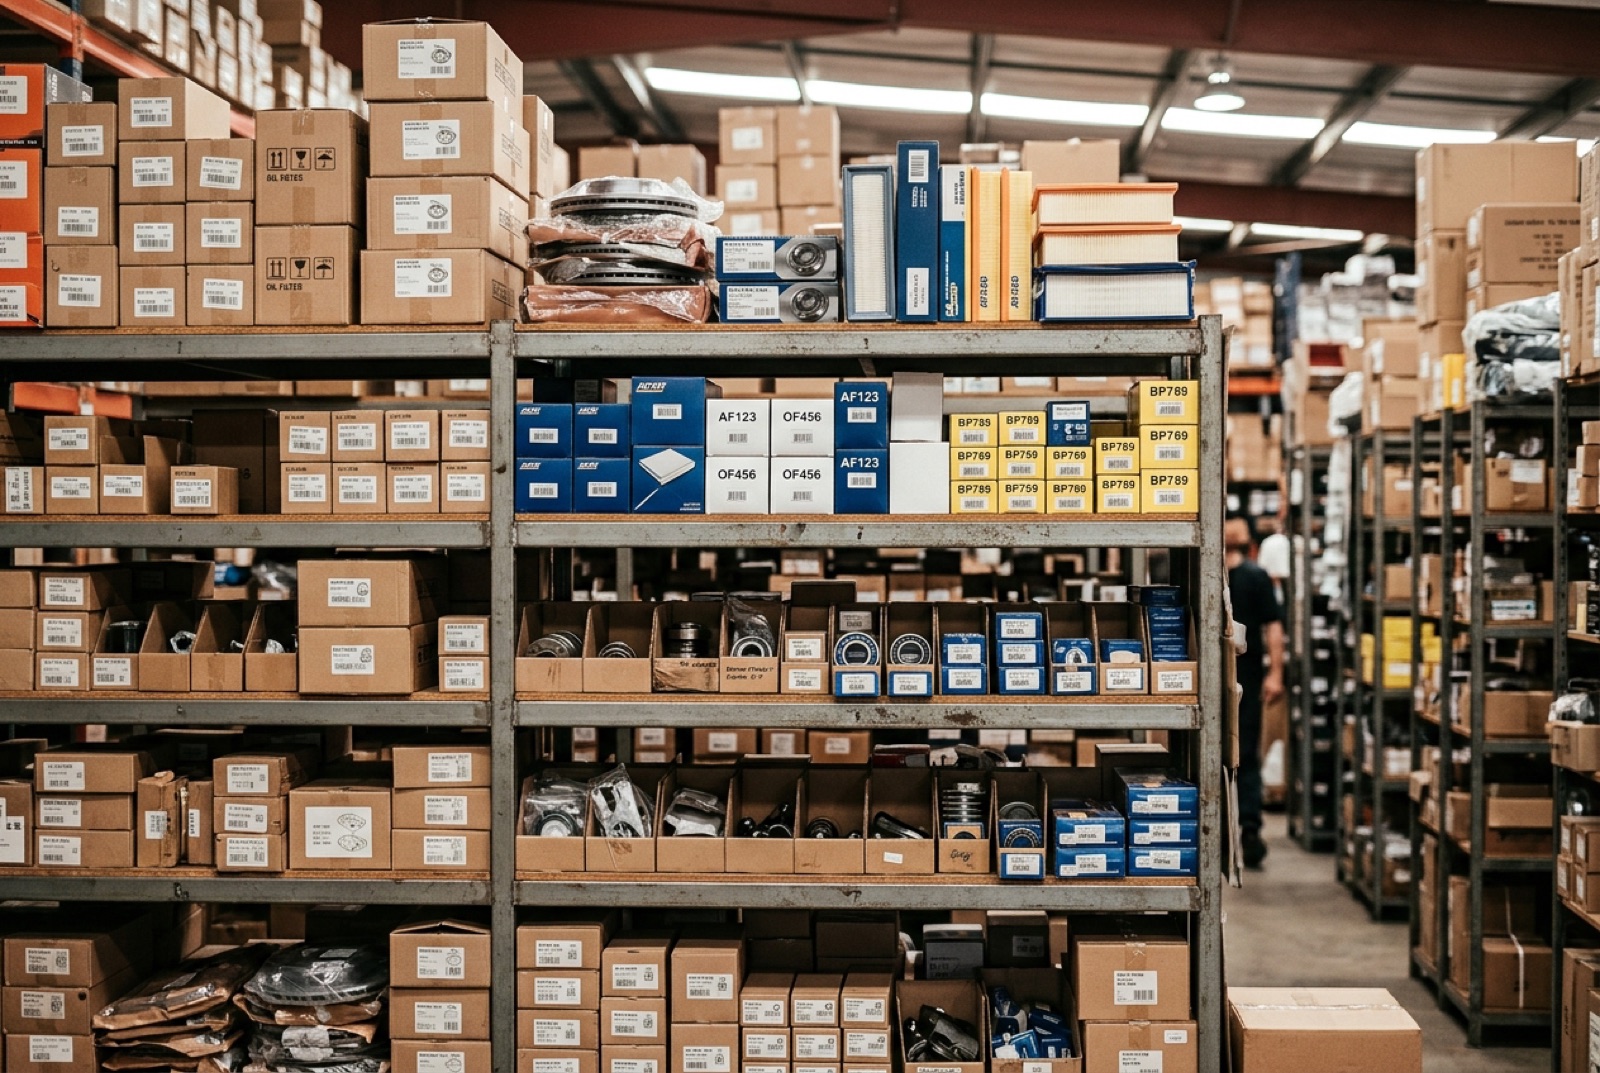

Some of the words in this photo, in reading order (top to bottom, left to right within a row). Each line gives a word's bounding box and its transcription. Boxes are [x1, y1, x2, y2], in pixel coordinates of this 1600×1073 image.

[840, 391, 879, 402] AF123
[1150, 386, 1188, 397] BP789
[718, 412, 757, 422] AF123
[782, 411, 822, 422] OF456
[840, 457, 879, 468] AF123
[718, 469, 757, 480] OF456
[782, 469, 821, 480] OF456
[1150, 475, 1188, 486] BP789
